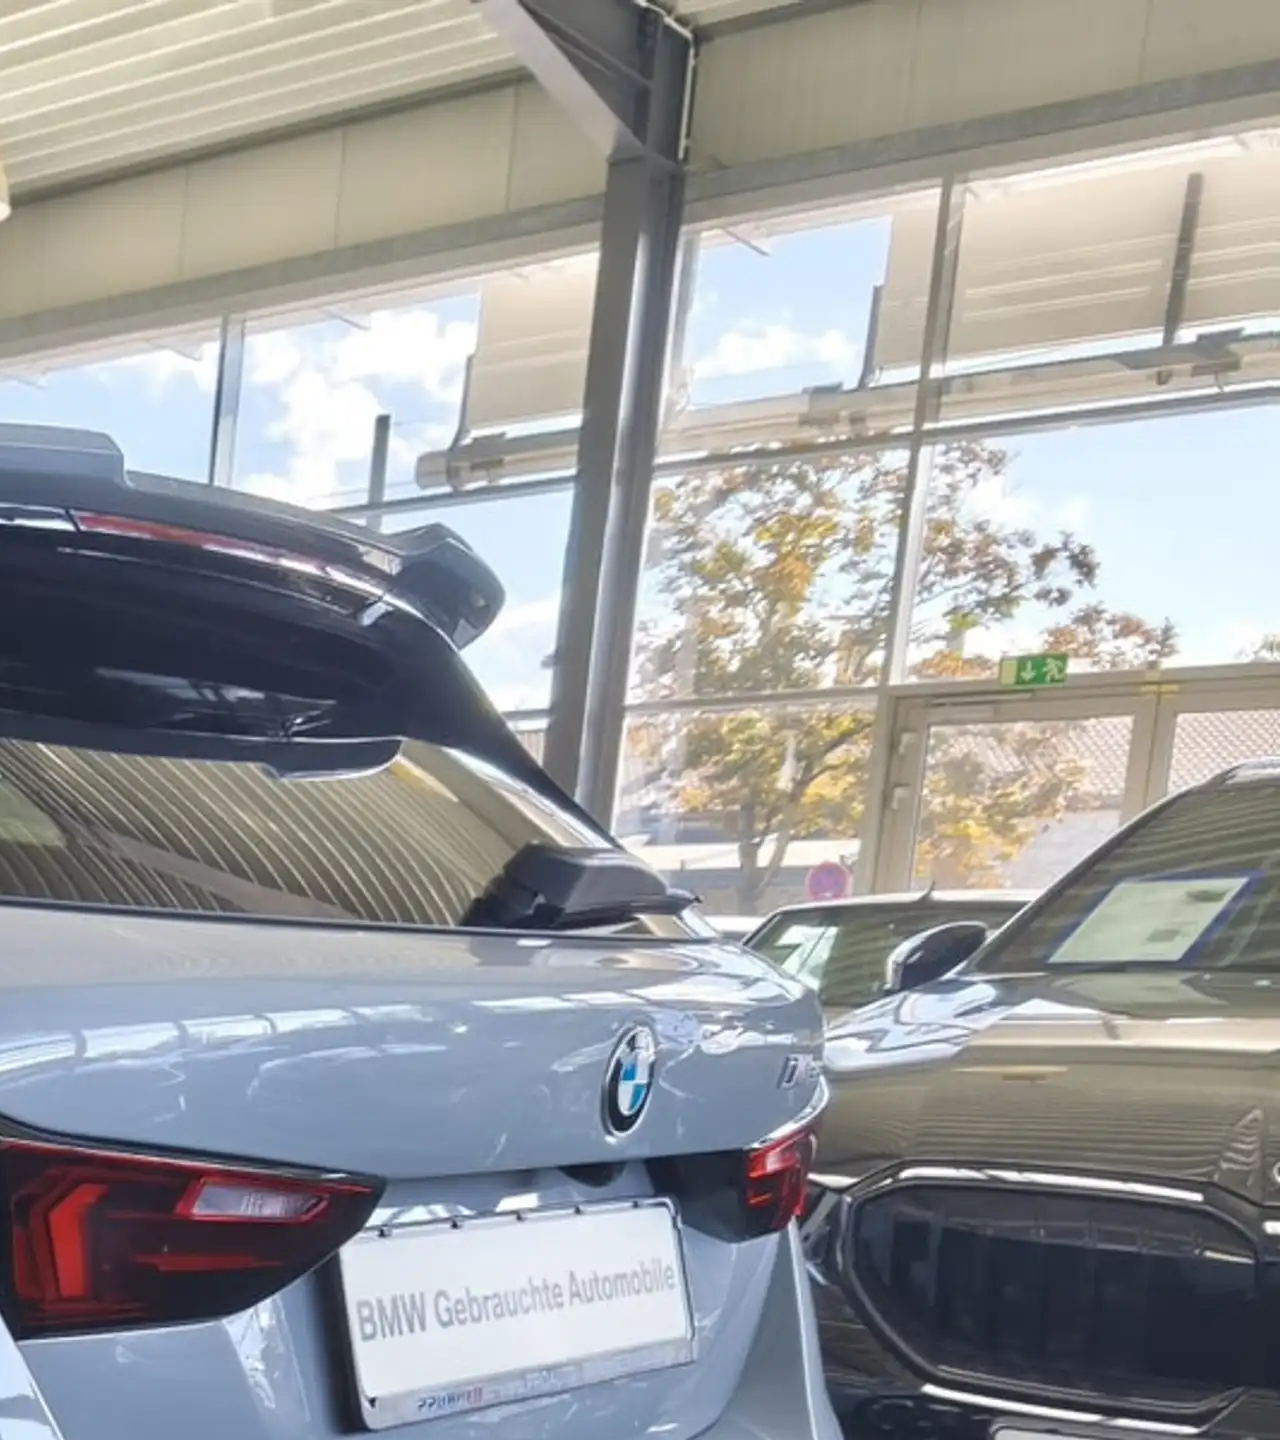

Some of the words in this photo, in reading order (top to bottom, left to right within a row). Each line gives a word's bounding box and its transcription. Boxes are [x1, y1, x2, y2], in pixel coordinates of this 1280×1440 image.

[356, 1291, 427, 1342] BMW
[433, 1275, 564, 1329] Gebrauchte
[568, 1257, 676, 1306] Automobile
